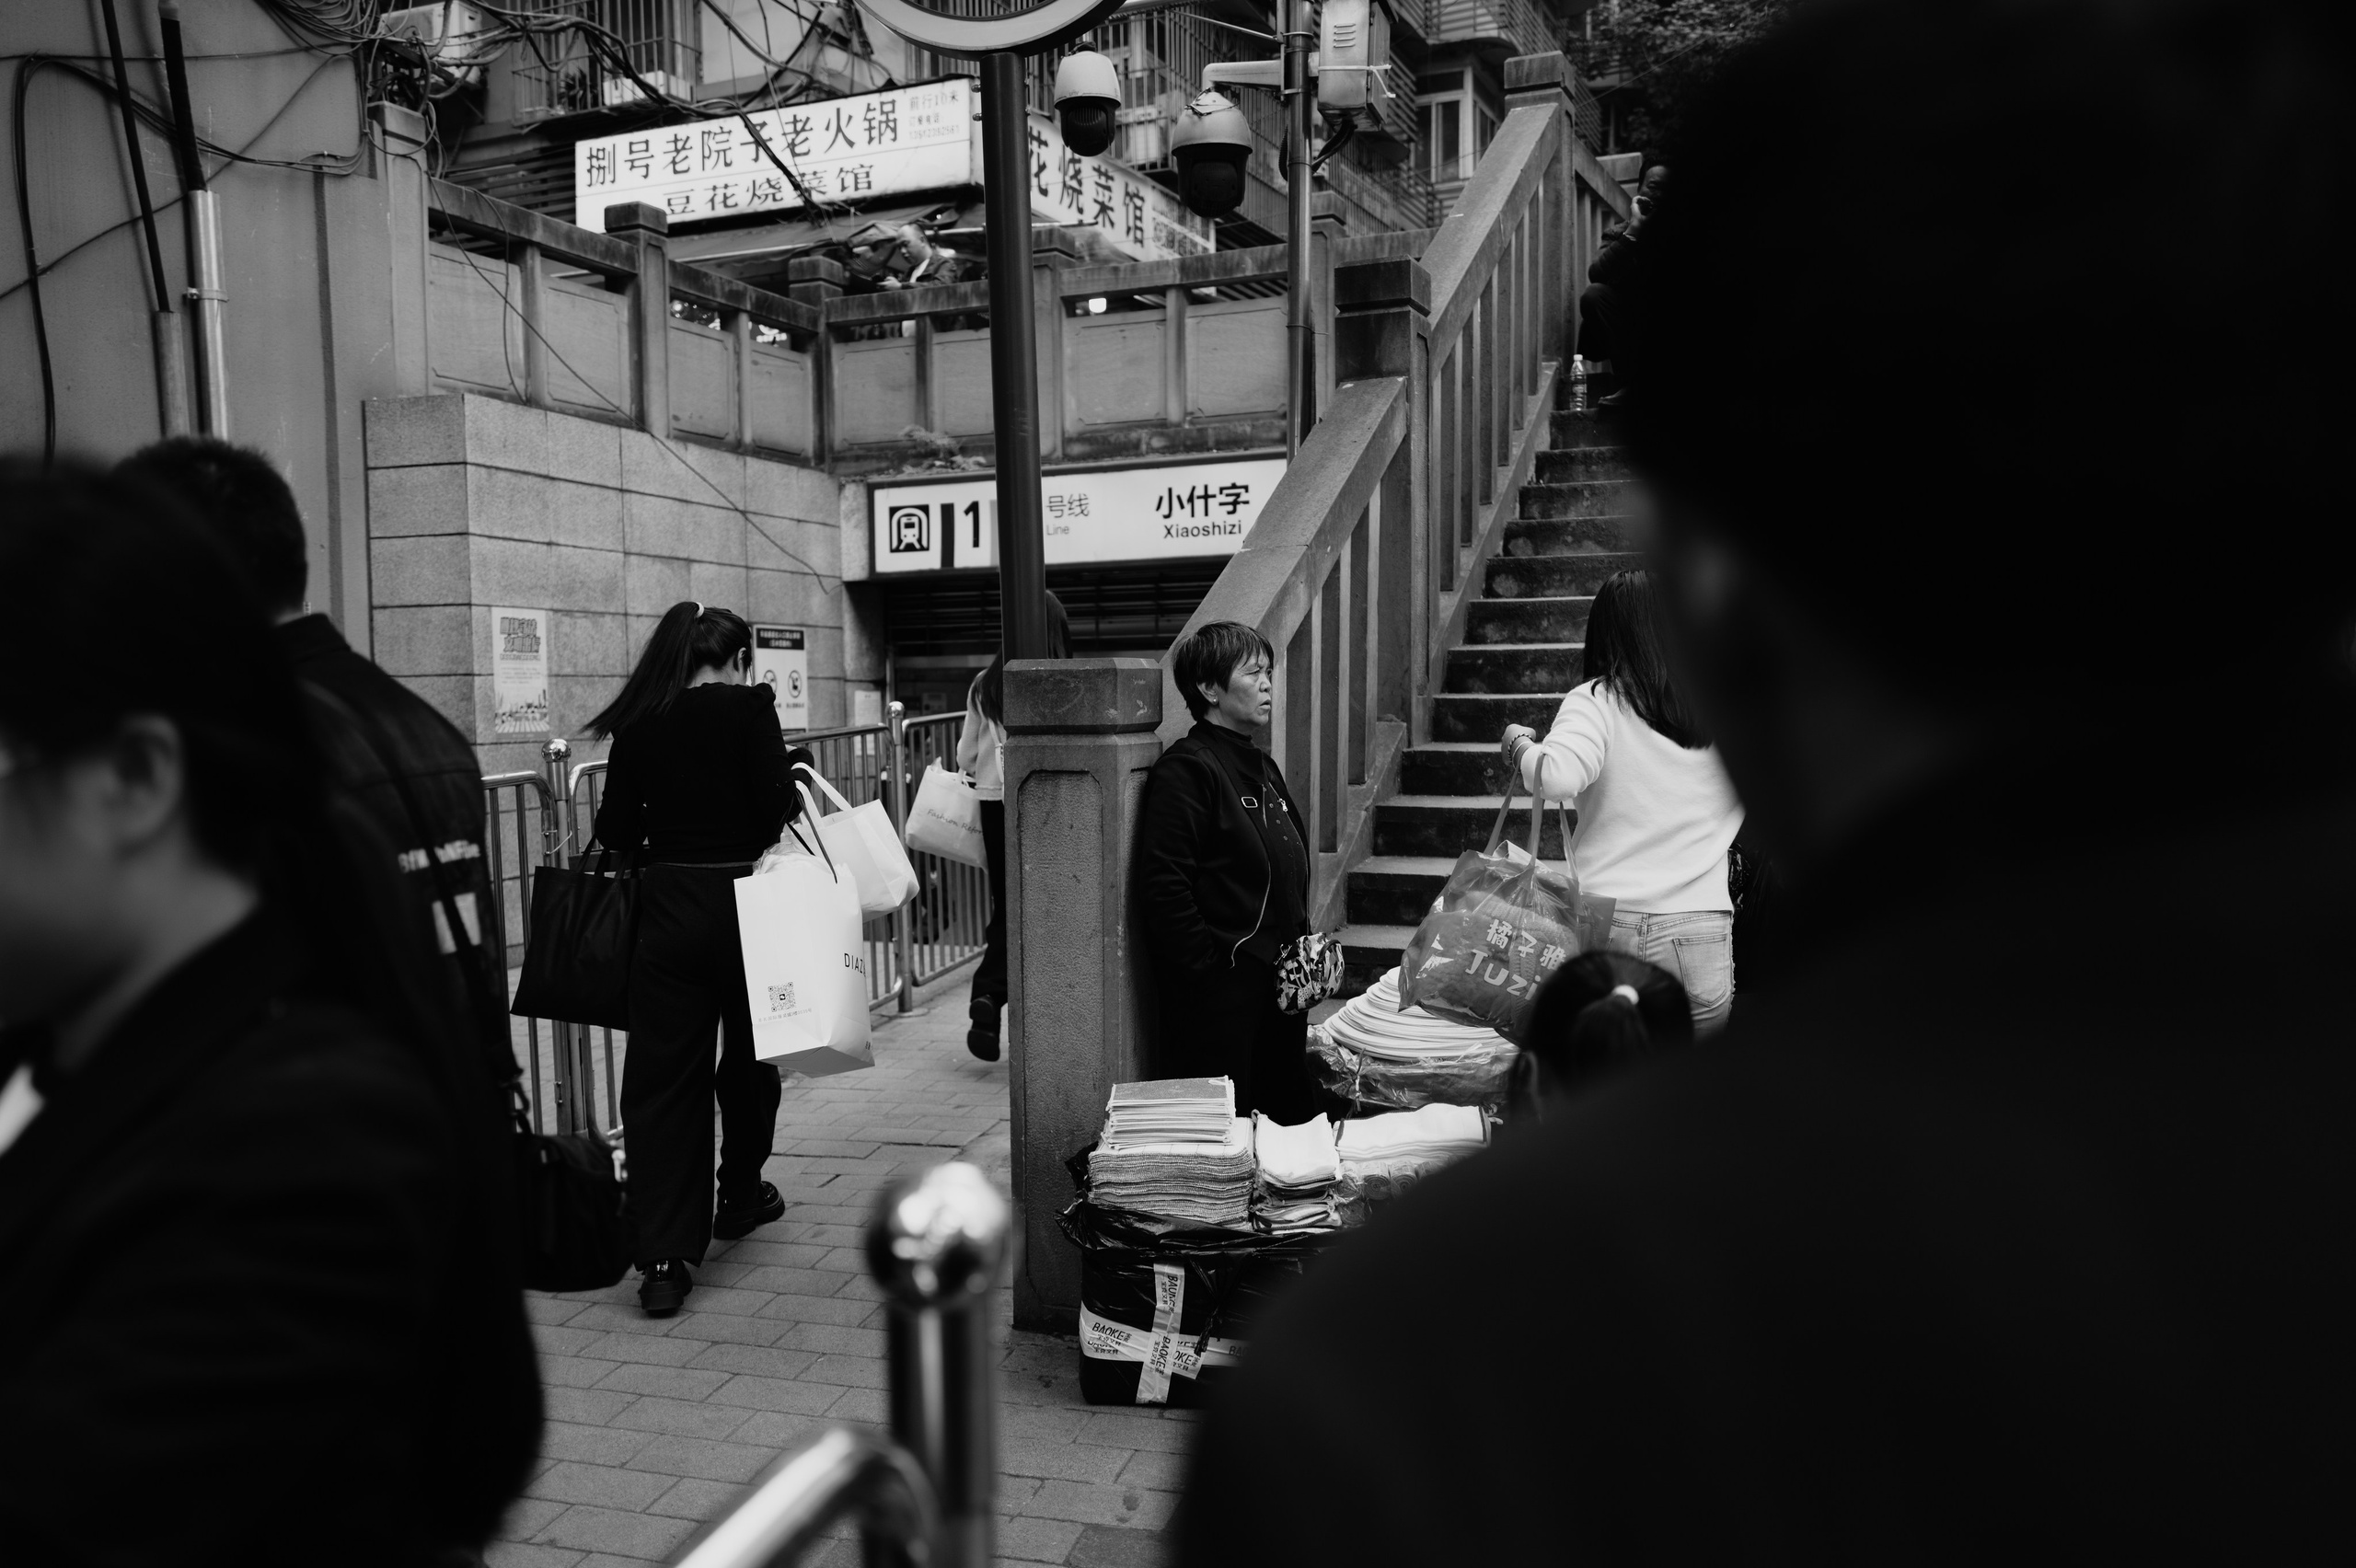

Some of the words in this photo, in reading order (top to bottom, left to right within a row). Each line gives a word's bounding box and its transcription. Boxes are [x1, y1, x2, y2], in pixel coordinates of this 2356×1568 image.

[586, 98, 898, 188] 捌号老院子老火锅
[664, 163, 874, 216] 豆花烧菜馆
[1045, 493, 1091, 519] 号线
[1155, 482, 1251, 520] 小什字
[964, 501, 980, 548] 1
[1046, 523, 1070, 536] Line
[1163, 520, 1242, 539] Xiaoshizi
[843, 952, 866, 977] DIAZ
[1091, 1322, 1126, 1341] BAOKE
[1156, 1335, 1172, 1369] BAOKE
[1173, 1350, 1194, 1366] OKE
